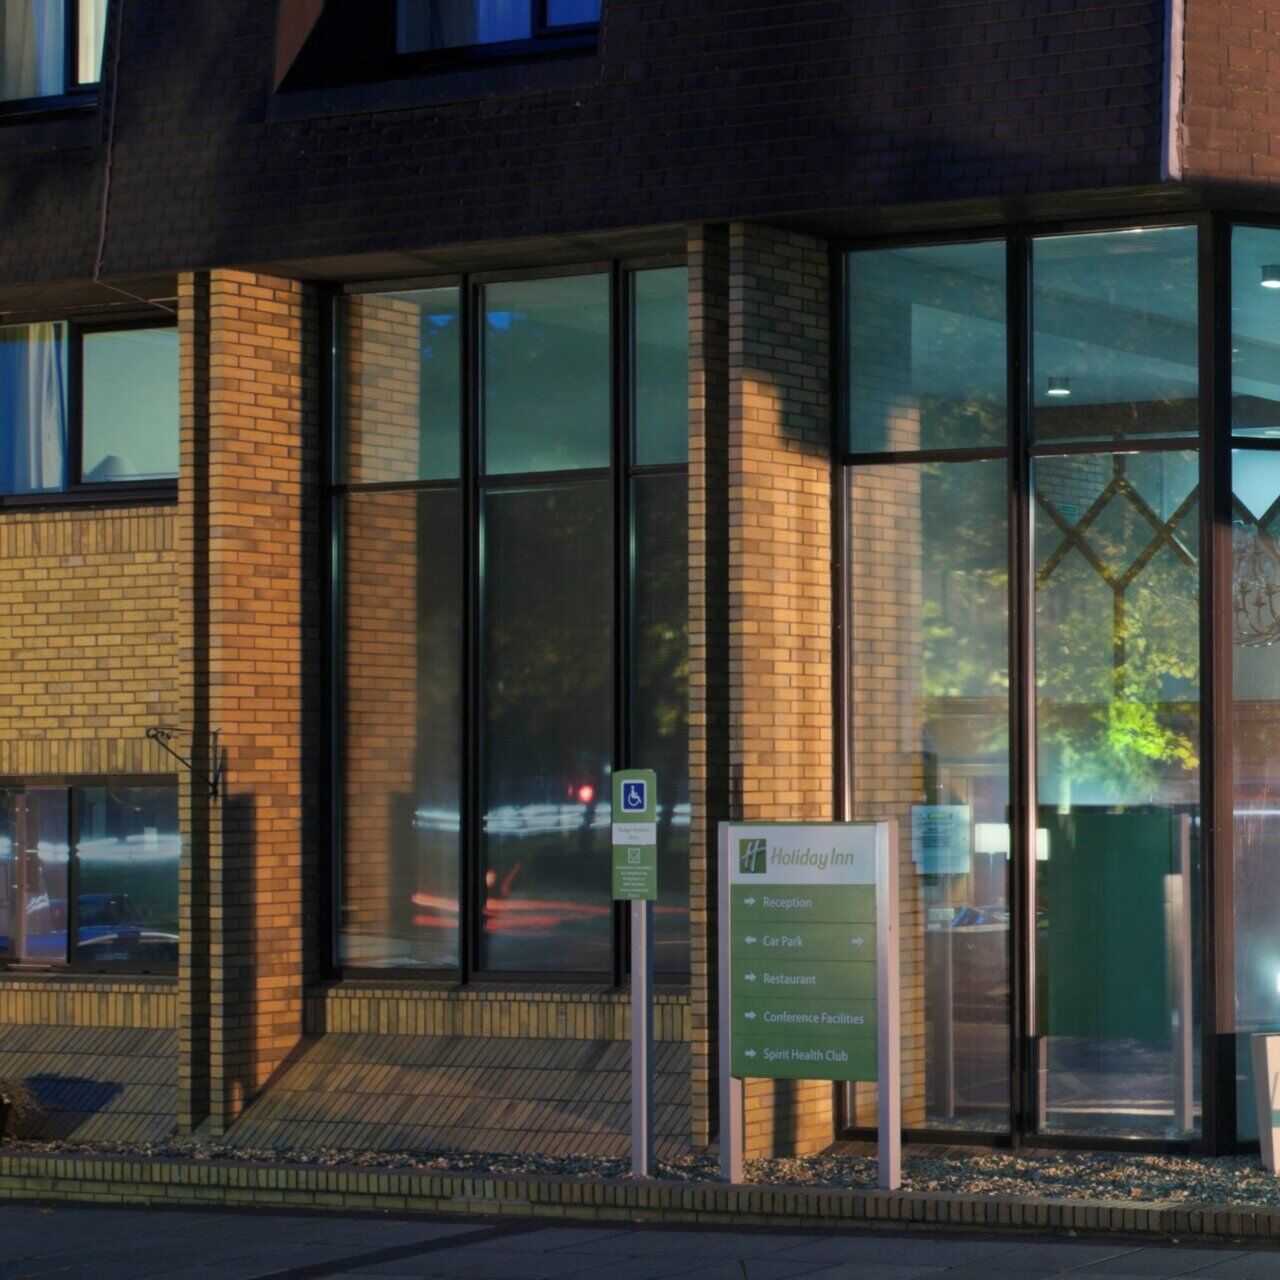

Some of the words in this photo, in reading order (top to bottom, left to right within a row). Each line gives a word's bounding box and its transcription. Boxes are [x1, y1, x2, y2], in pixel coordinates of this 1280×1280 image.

[771, 847, 828, 870] Holiday
[830, 847, 854, 866] Inn
[763, 896, 812, 909] Reception
[763, 935, 779, 947] Car
[781, 935, 804, 948] Park
[763, 973, 816, 985] Restaurant
[763, 1011, 820, 1024] Conference
[822, 1012, 865, 1025] Facilities
[763, 1048, 790, 1062] Spirit
[791, 1048, 824, 1061] Health
[825, 1050, 848, 1062] Club
